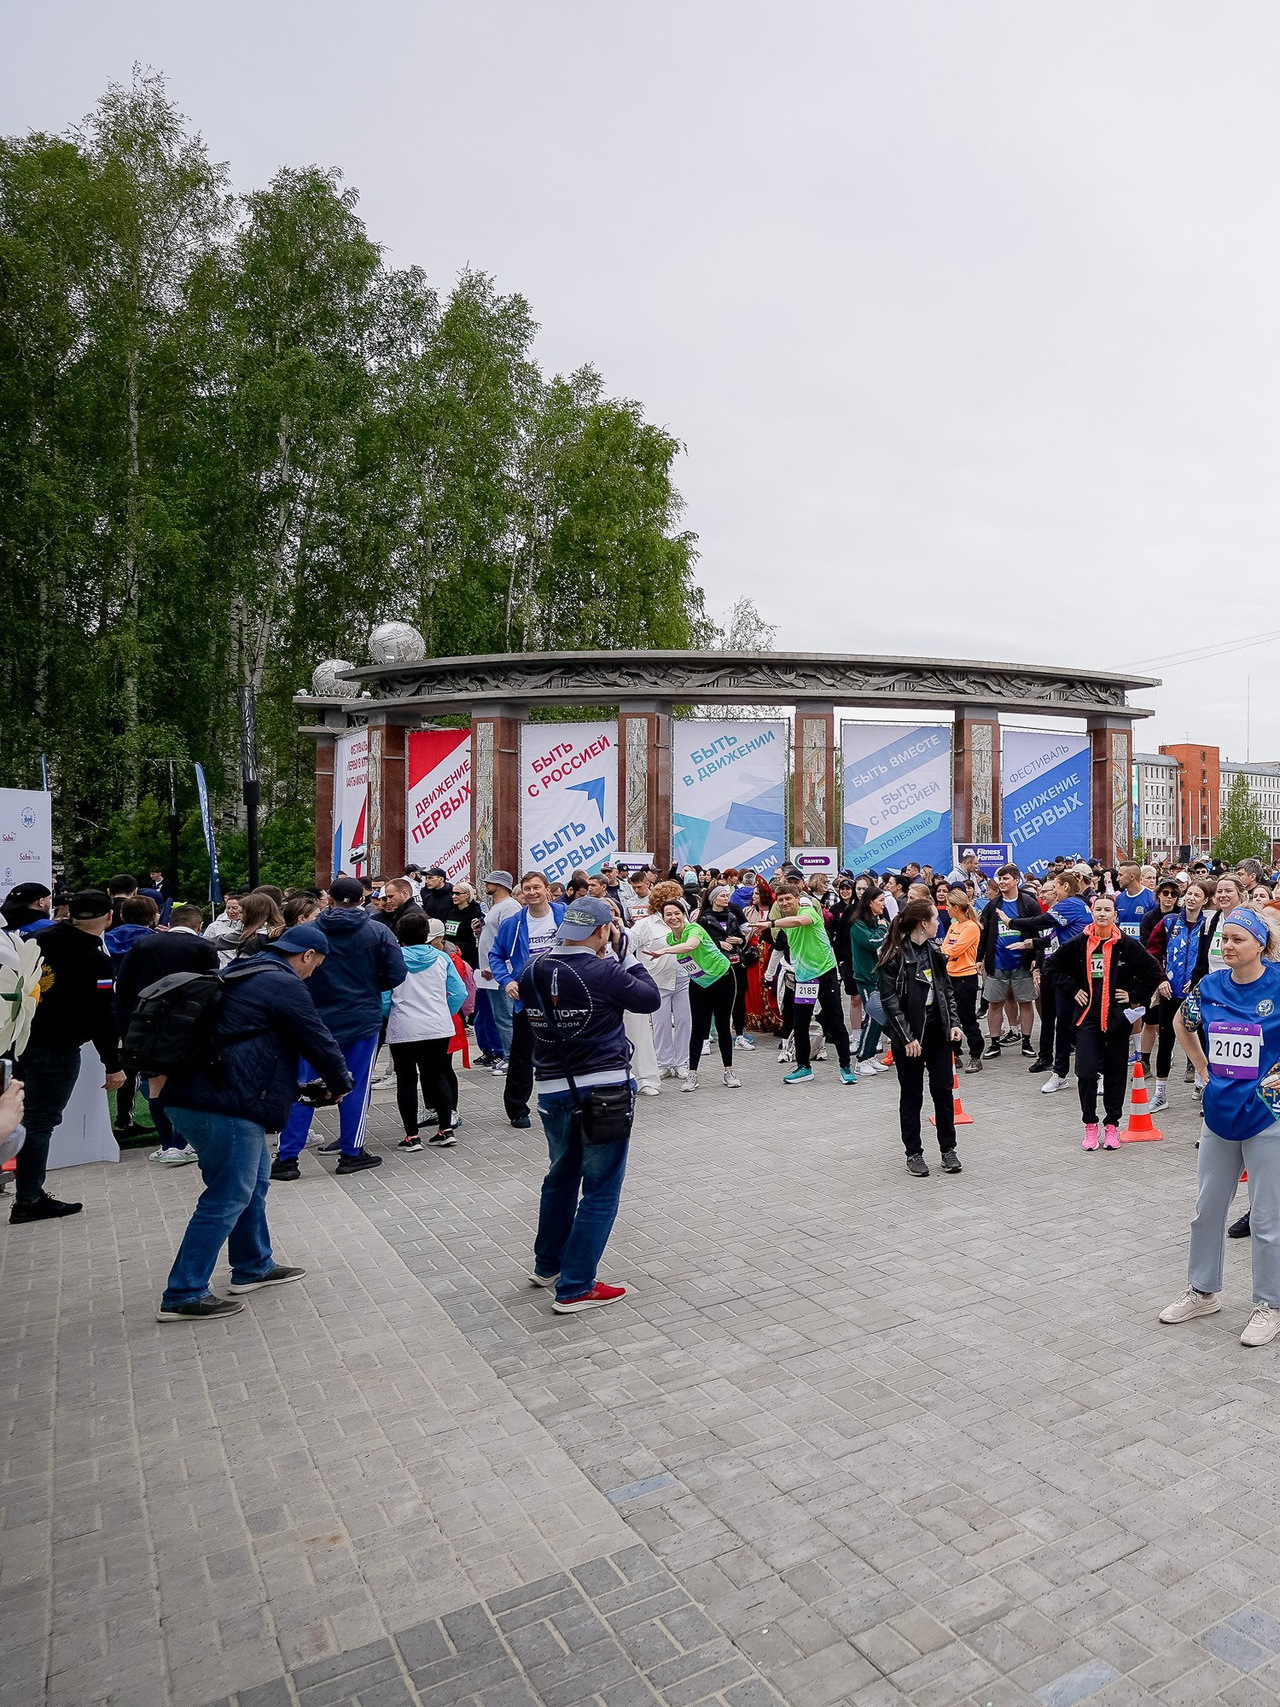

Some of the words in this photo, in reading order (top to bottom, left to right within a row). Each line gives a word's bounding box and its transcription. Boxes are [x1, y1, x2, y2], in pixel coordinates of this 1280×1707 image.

[527, 784, 540, 797] С
[541, 734, 611, 789] РОССИЕЙ
[531, 742, 573, 774] БЫТЬ
[682, 774, 695, 787] В
[697, 730, 776, 782] ДВИЖЕНИИ
[690, 735, 738, 765] БЫТЬ
[852, 764, 888, 788] БЫТЬ
[890, 734, 941, 768] ВМЕСТЕ
[1009, 744, 1070, 783] ФЕСТИВАЛЬ
[411, 780, 471, 844] ПЕРВЫХ
[414, 759, 471, 818] ДВИЖЕНИЕ
[869, 815, 880, 826] С
[881, 780, 940, 820] РОССИЕЙ
[881, 782, 917, 806] БЫТЬ
[1012, 772, 1081, 823] ДВИЖЕНИЕ
[530, 821, 587, 863] БЫТЬ
[853, 848, 880, 866] БЫТЬ
[880, 816, 933, 853] ПОЛЕЗНЫМ
[1008, 792, 1084, 847] ПЕРВЫХ
[542, 826, 616, 883] ЕРВЫМ
[1215, 1040, 1253, 1059] 2103
